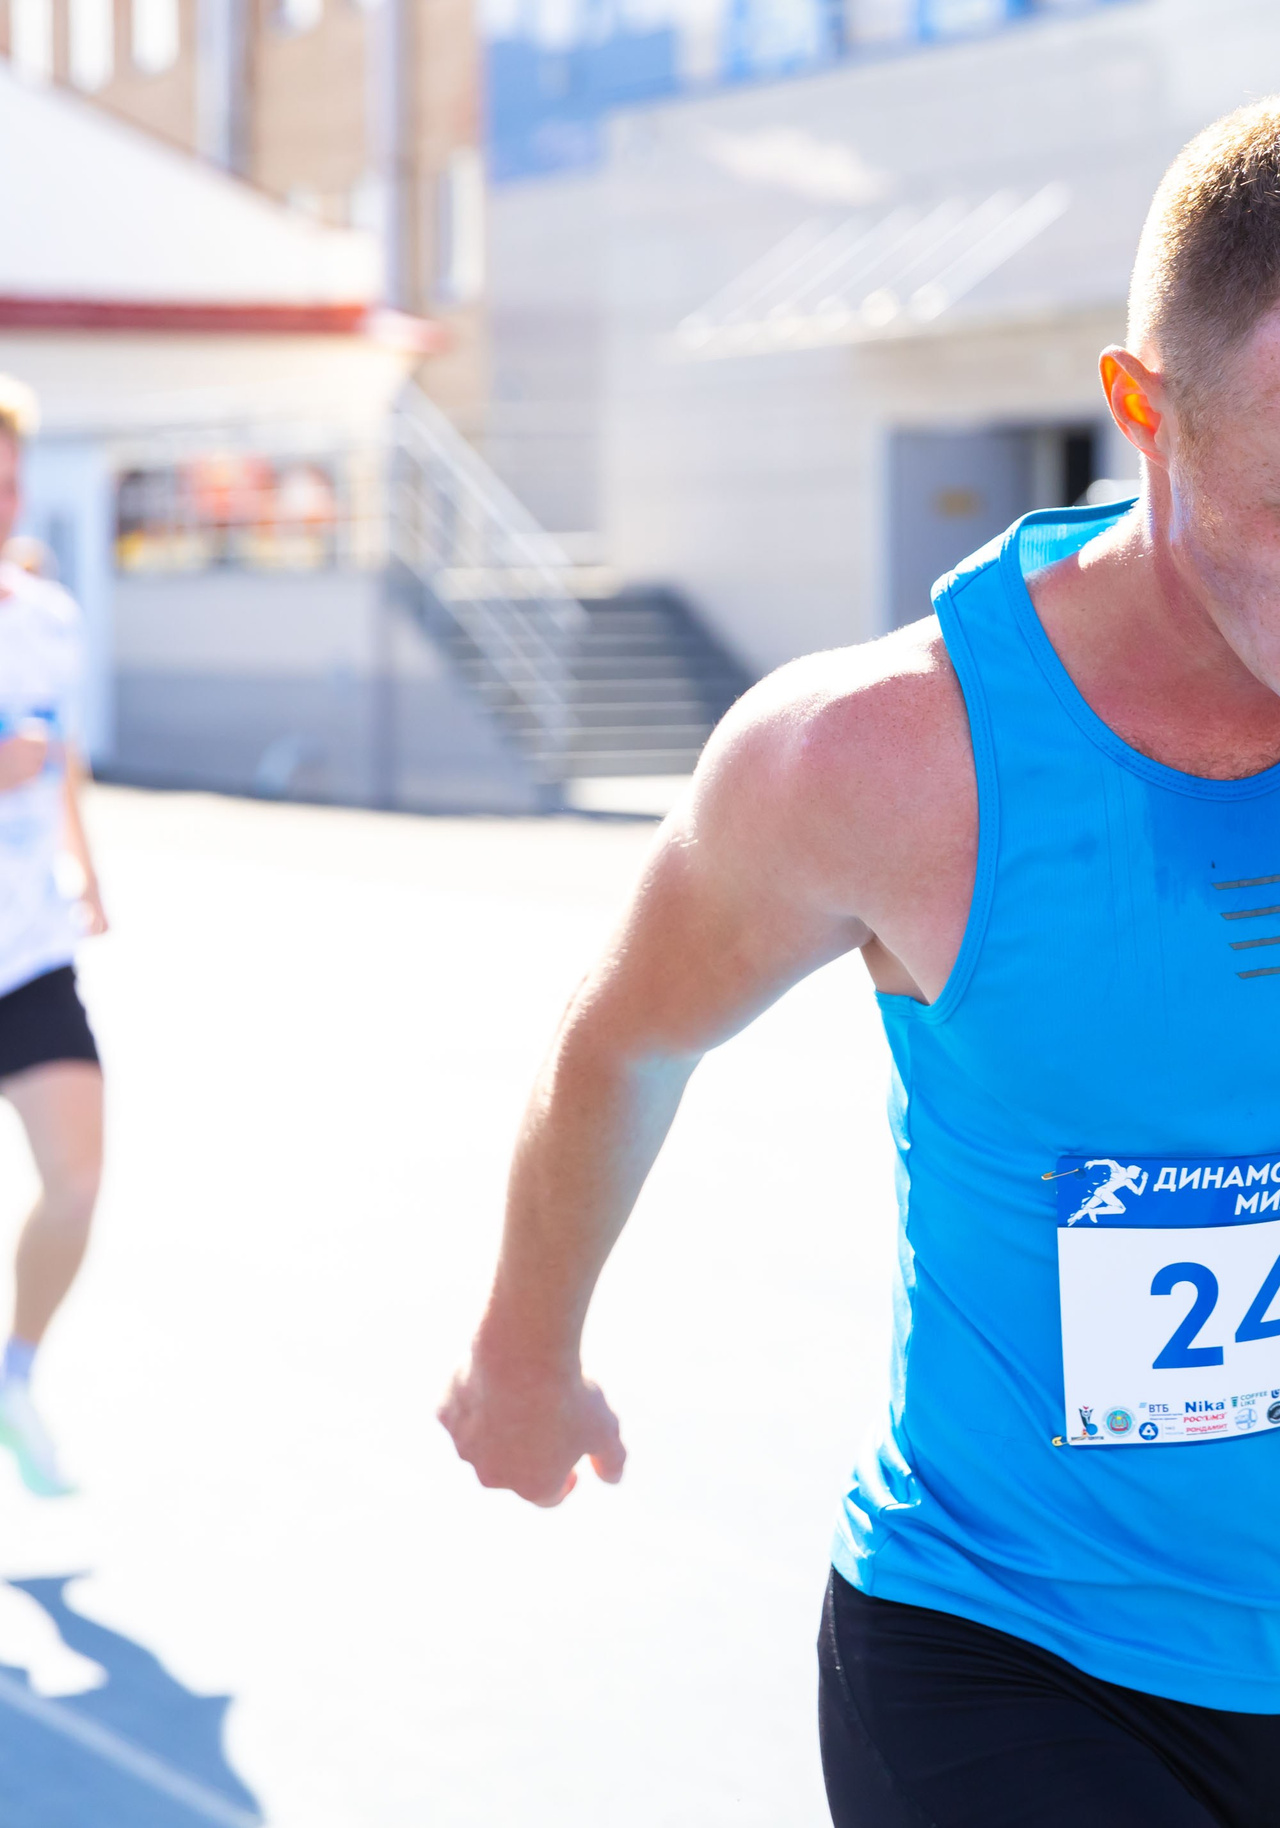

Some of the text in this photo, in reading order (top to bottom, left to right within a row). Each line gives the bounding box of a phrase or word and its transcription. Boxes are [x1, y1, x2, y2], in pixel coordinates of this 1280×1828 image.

[1240, 1391, 1268, 1401] COFFEE
[1185, 1400, 1225, 1413] Nika
[1240, 1399, 1256, 1407] LIKE
[1149, 1404, 1169, 1413] ВТБ
